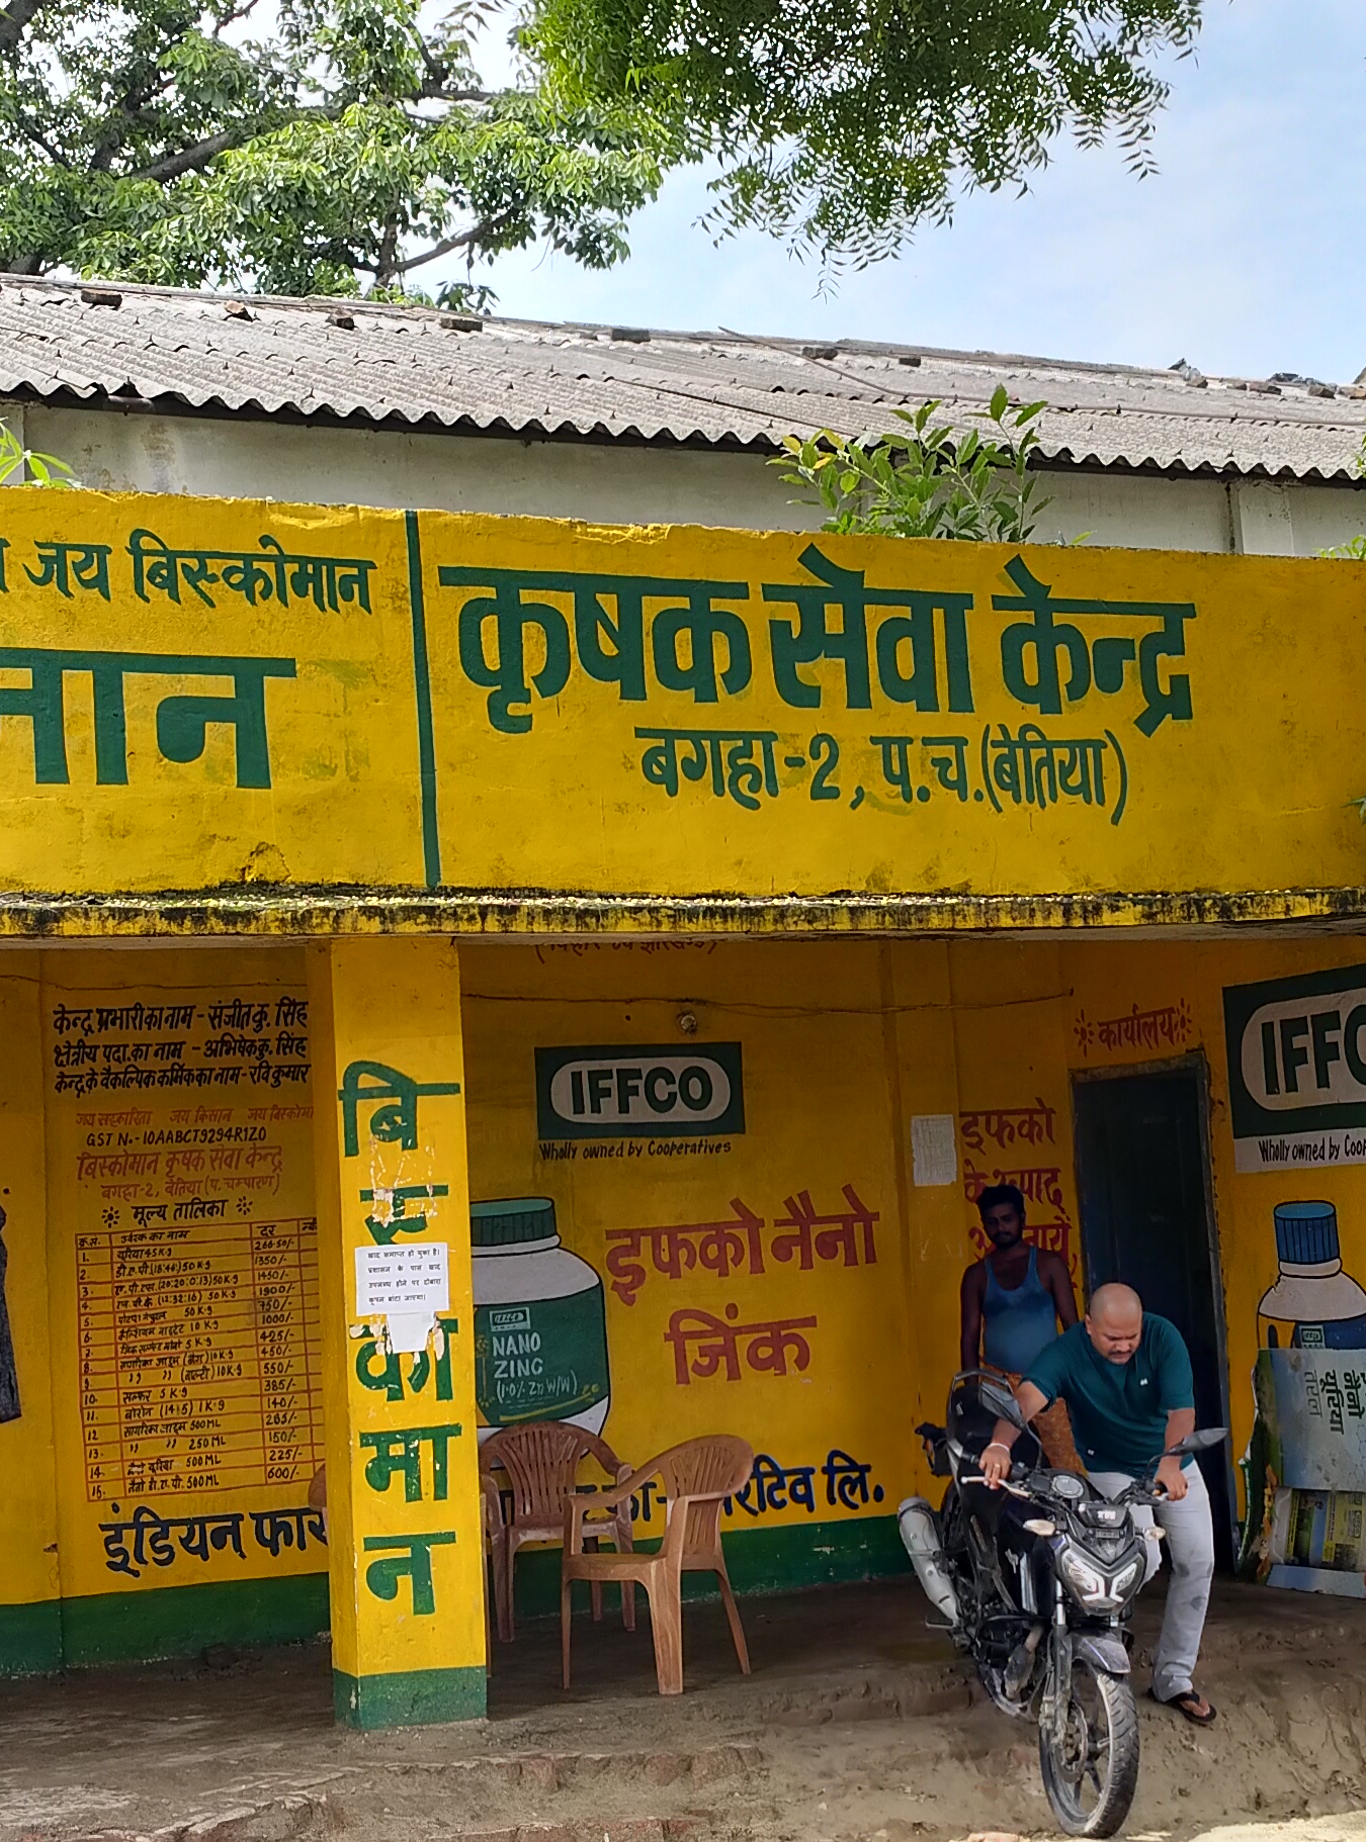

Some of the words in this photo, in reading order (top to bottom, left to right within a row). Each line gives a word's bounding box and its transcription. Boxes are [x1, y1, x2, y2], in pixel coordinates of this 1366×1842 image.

[24, 541, 112, 601] जय
[126, 529, 377, 614] बिस्कोमान
[438, 565, 753, 733] कृषक
[761, 543, 975, 713] सेवा
[991, 553, 1196, 738] केन्द्र
[164, 1004, 197, 1030] नाम
[274, 996, 309, 1029] सिंह
[1098, 1003, 1177, 1051] कार्यालय
[153, 1041, 187, 1061] नाम
[275, 1031, 309, 1058] सिंह
[570, 1065, 713, 1116] IFFCO
[86, 1132, 114, 1148] GST
[539, 1141, 578, 1161] Wholly
[583, 1141, 624, 1159] owned
[628, 1141, 643, 1158] by
[647, 1138, 731, 1157] Cooperatives
[959, 1096, 1056, 1156] इफको
[1258, 1136, 1290, 1163] Wholly
[1291, 1137, 1325, 1162] owned
[1328, 1137, 1340, 1161] by
[130, 1204, 168, 1228] मूल्य
[173, 1196, 230, 1220] तालिका
[605, 1197, 765, 1307] इफको
[771, 1183, 880, 1271] नैनो
[492, 1332, 541, 1357] NANO
[494, 1357, 544, 1379] ZINC
[664, 1302, 818, 1386] जिंक
[1304, 1369, 1323, 1419] तरल
[1319, 1369, 1345, 1435] यूरिया
[1344, 1369, 1366, 1420] नैनो
[822, 1450, 885, 1510] लि.
[98, 1502, 247, 1578] इंडियन
